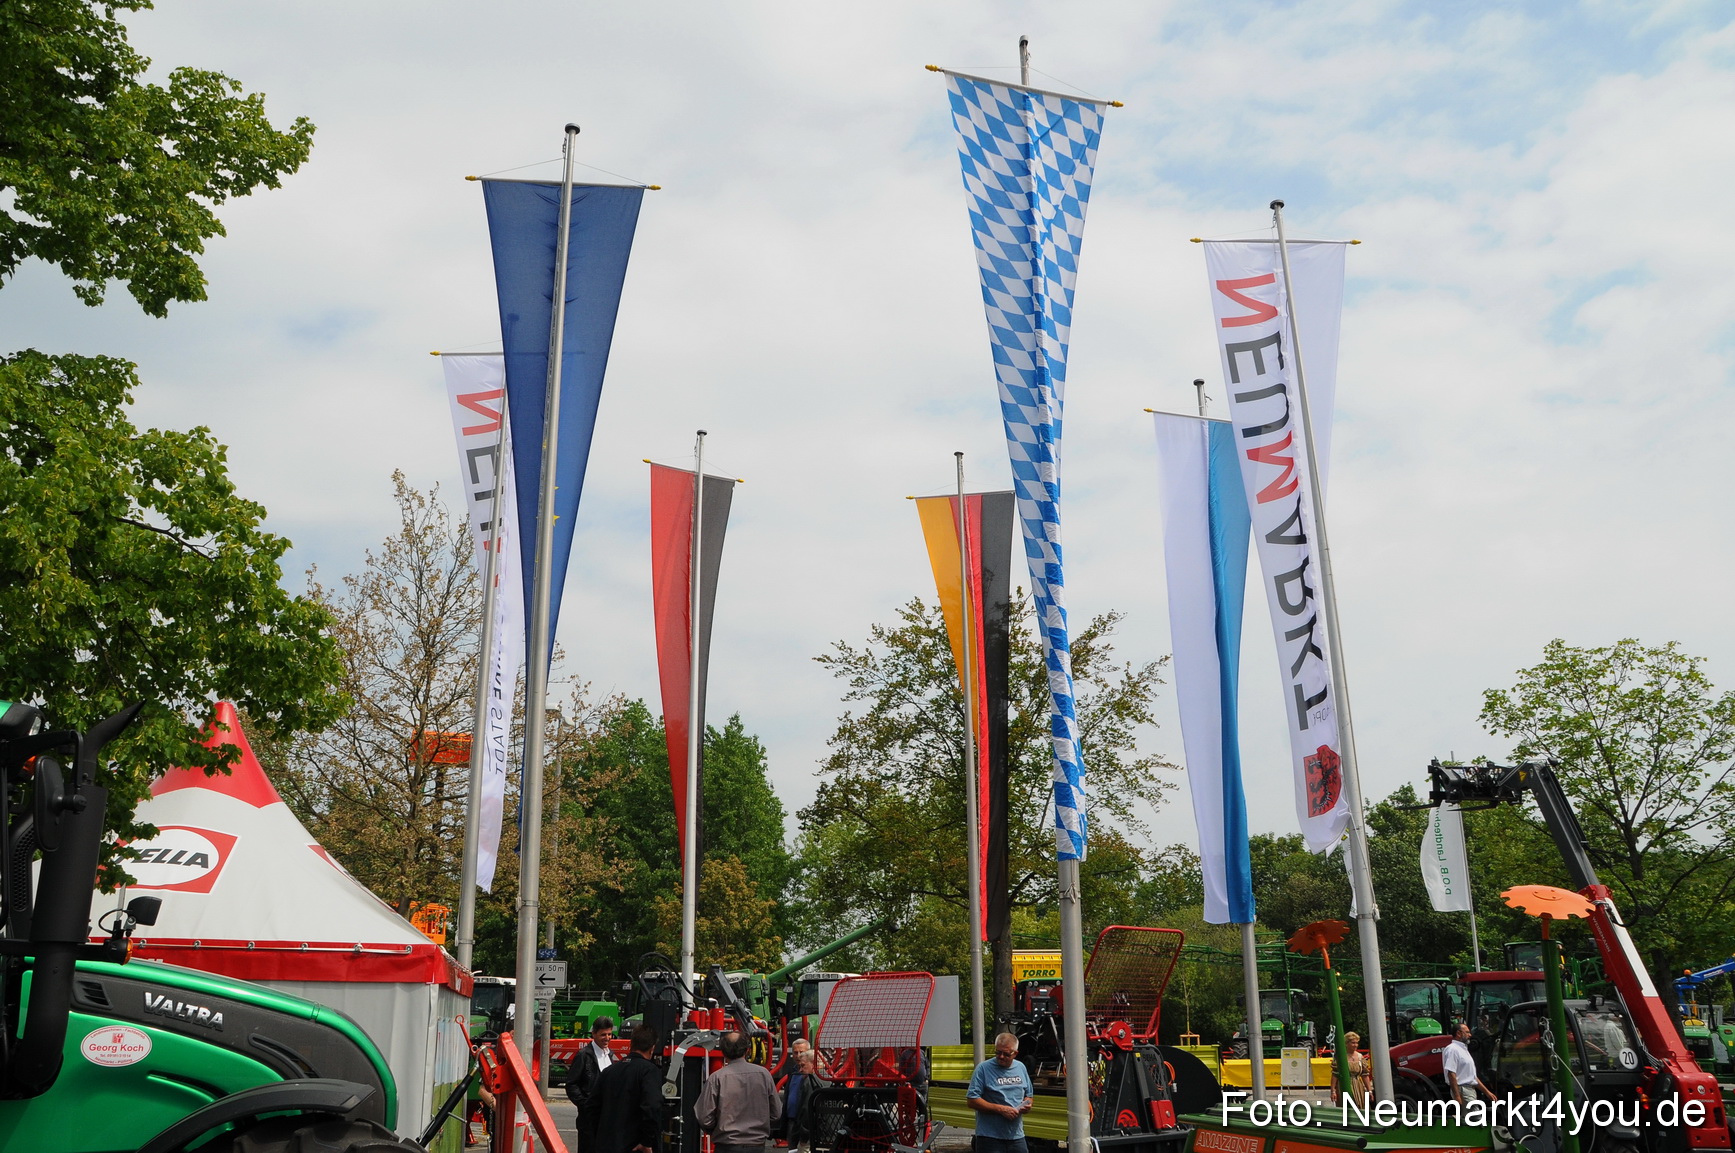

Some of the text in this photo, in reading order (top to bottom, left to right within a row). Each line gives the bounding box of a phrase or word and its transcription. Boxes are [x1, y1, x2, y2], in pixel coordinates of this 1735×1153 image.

[115, 848, 209, 869] ELLA
[1023, 969, 1056, 977] TORRO
[144, 991, 224, 1032] VALTRA
[89, 1043, 144, 1054] Georg Koch
[1622, 1051, 1635, 1065] 20
[1195, 1131, 1259, 1153] AMAZONE
